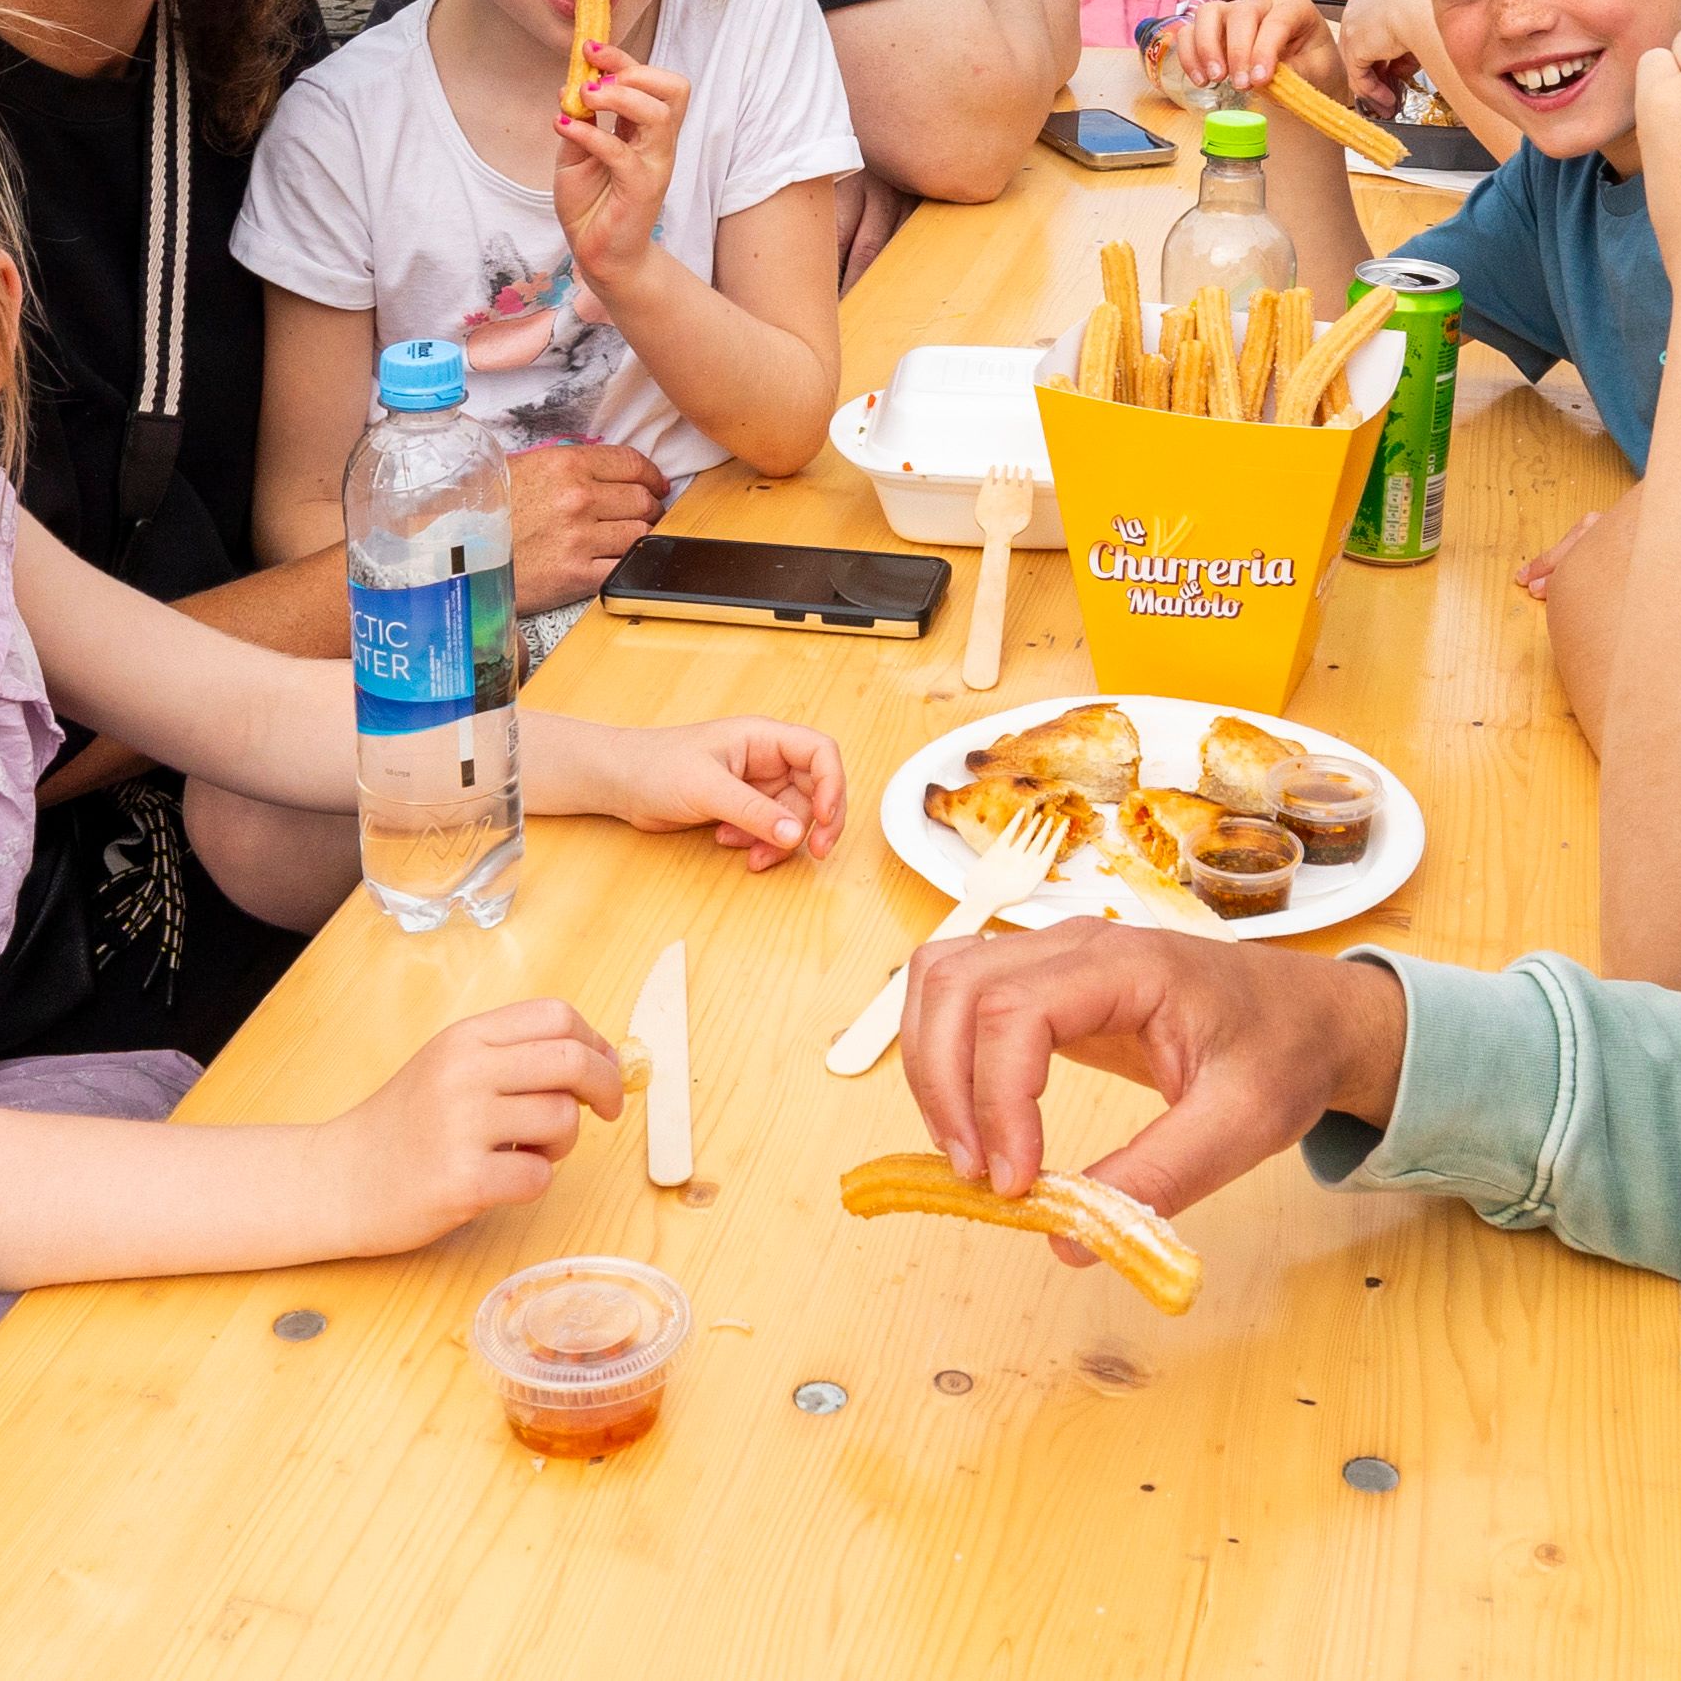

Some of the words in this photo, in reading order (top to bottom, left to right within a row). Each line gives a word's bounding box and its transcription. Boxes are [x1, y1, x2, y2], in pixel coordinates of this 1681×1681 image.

[1111, 514, 1147, 545] La
[1087, 540, 1297, 587] Churreria
[1126, 585, 1244, 620] Manolo
[1179, 578, 1203, 601] de
[352, 641, 411, 681] ATER
